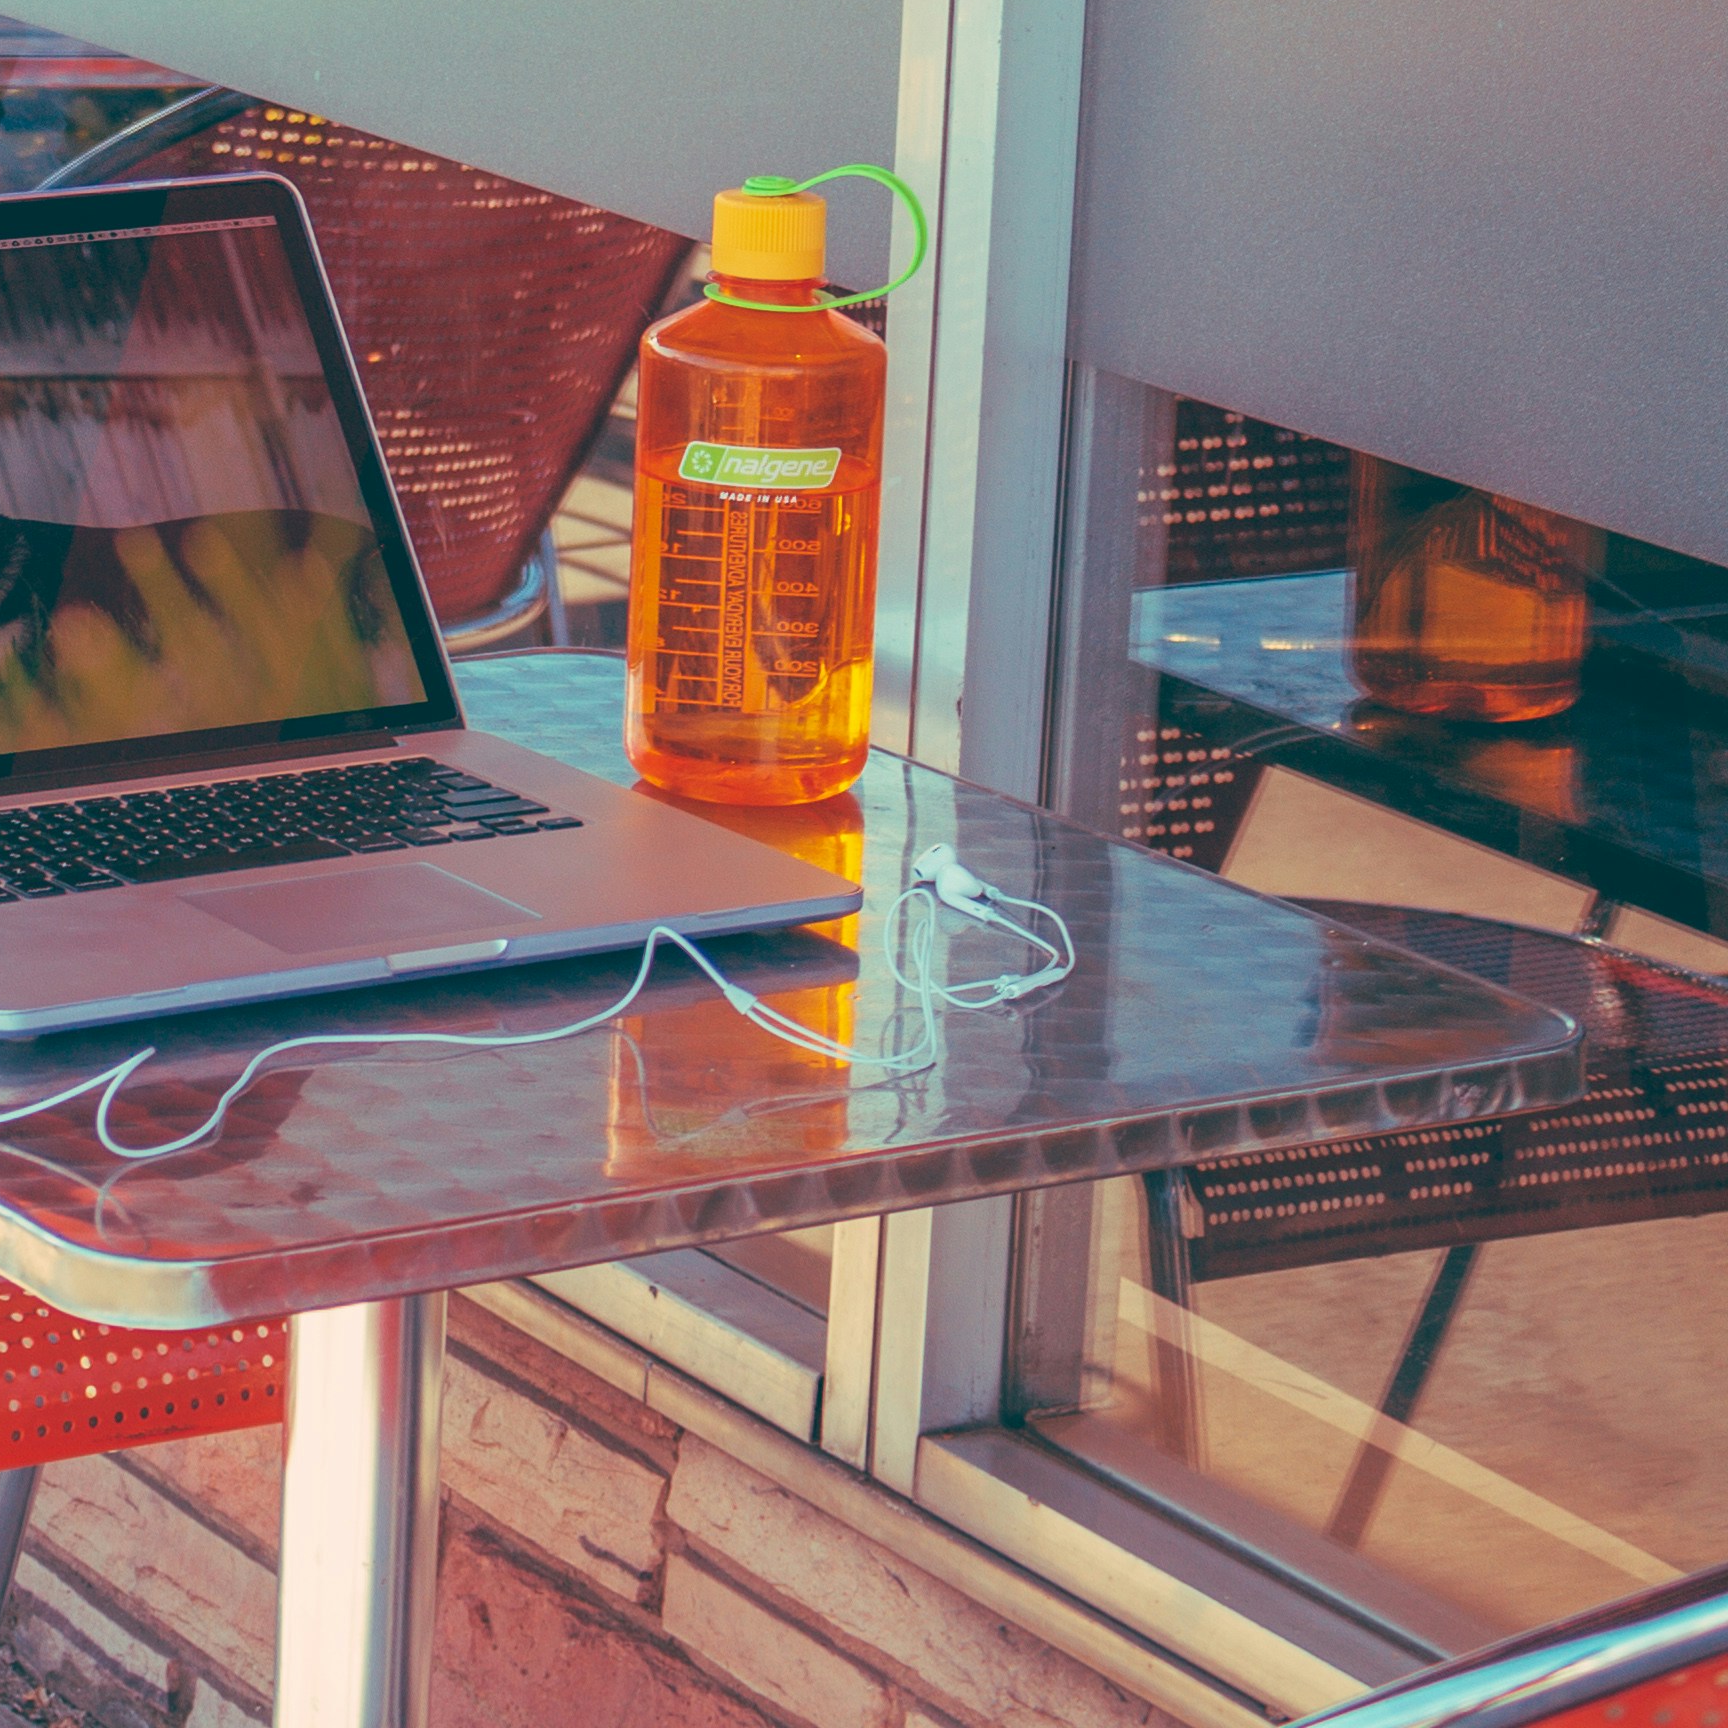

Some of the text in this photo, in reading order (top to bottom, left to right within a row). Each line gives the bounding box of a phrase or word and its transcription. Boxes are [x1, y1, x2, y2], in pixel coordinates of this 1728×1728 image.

[724, 454, 829, 483] nalgene
[719, 491, 798, 505] MADE IN USA
